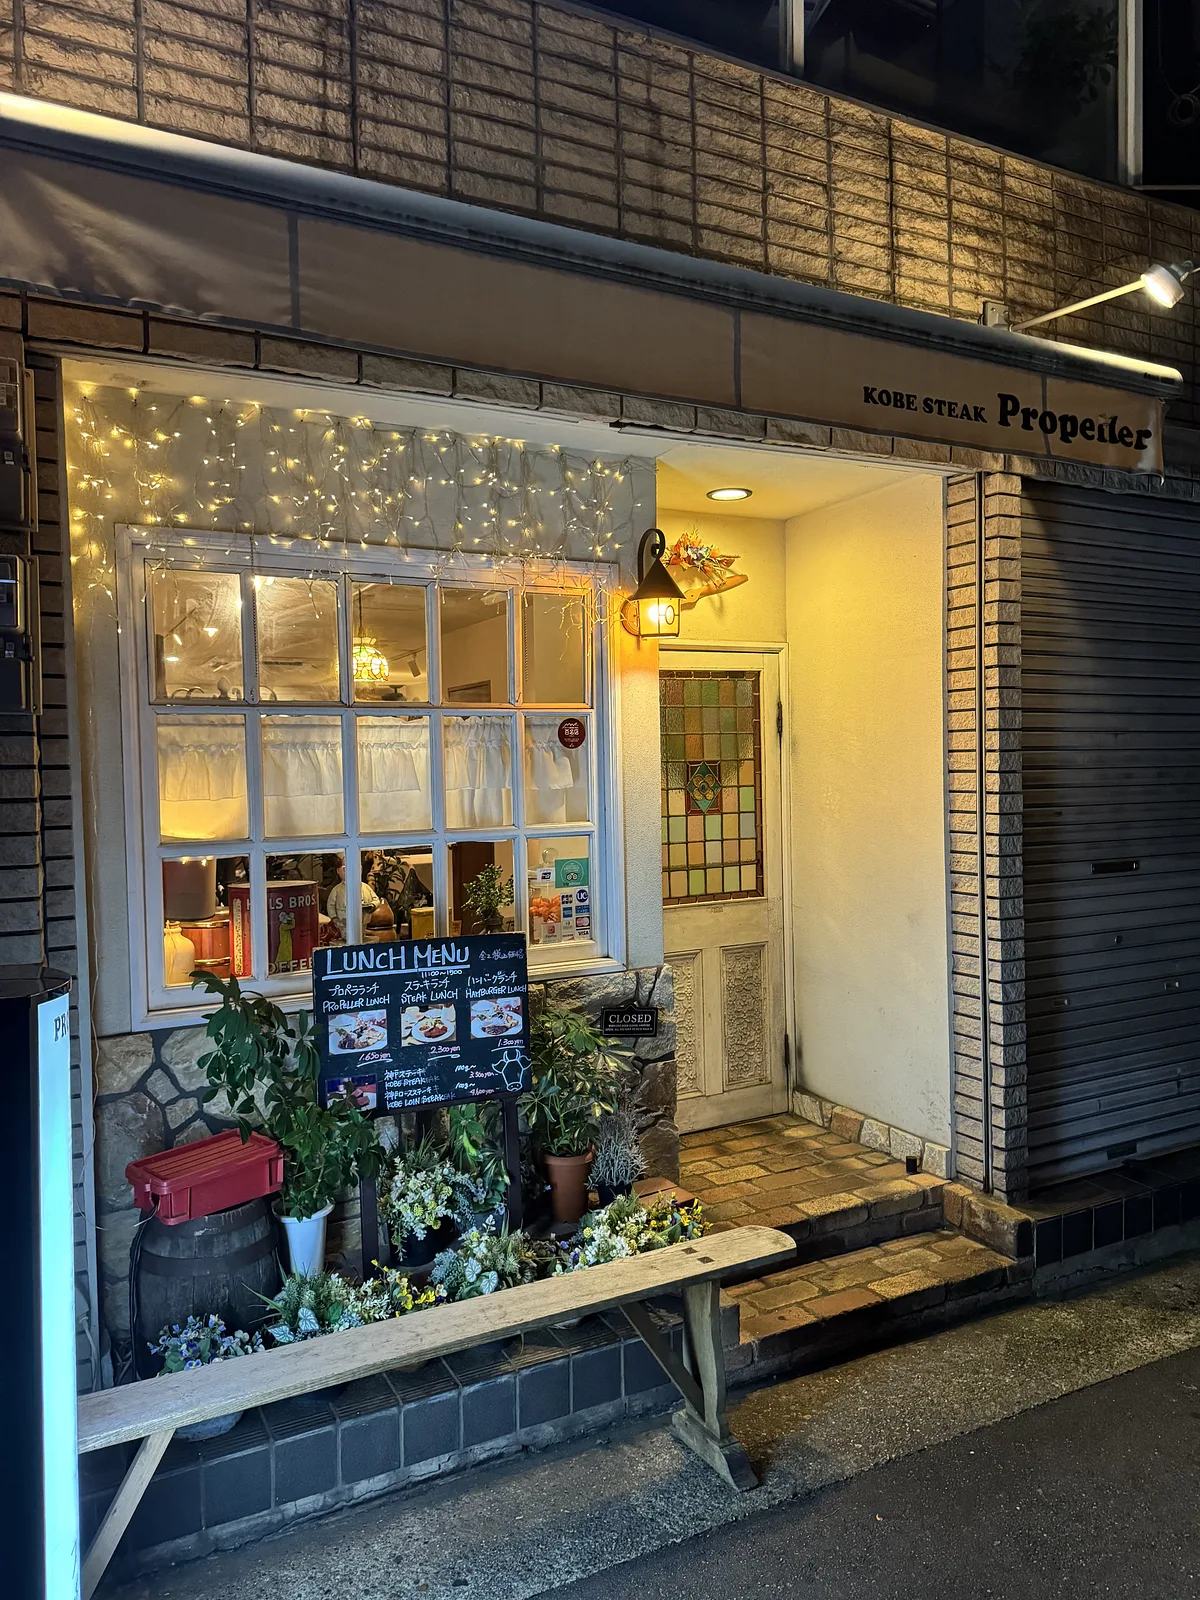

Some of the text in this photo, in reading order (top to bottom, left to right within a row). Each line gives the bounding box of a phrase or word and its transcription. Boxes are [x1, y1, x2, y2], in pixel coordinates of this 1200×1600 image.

[863, 385, 918, 413] KOBE
[922, 398, 987, 424] STEAK
[326, 941, 470, 974] LUNCH MENU
[328, 982, 380, 997] プロペラランチ
[404, 976, 451, 992] ステーキランチ
[507, 984, 527, 994] LUNCH
[365, 993, 390, 1007] LUNCH
[401, 988, 458, 1005] STEAK LUNCH
[609, 1014, 652, 1023] CLOSED
[54, 1011, 70, 1042] PR
[404, 1097, 421, 1107] LOIN
